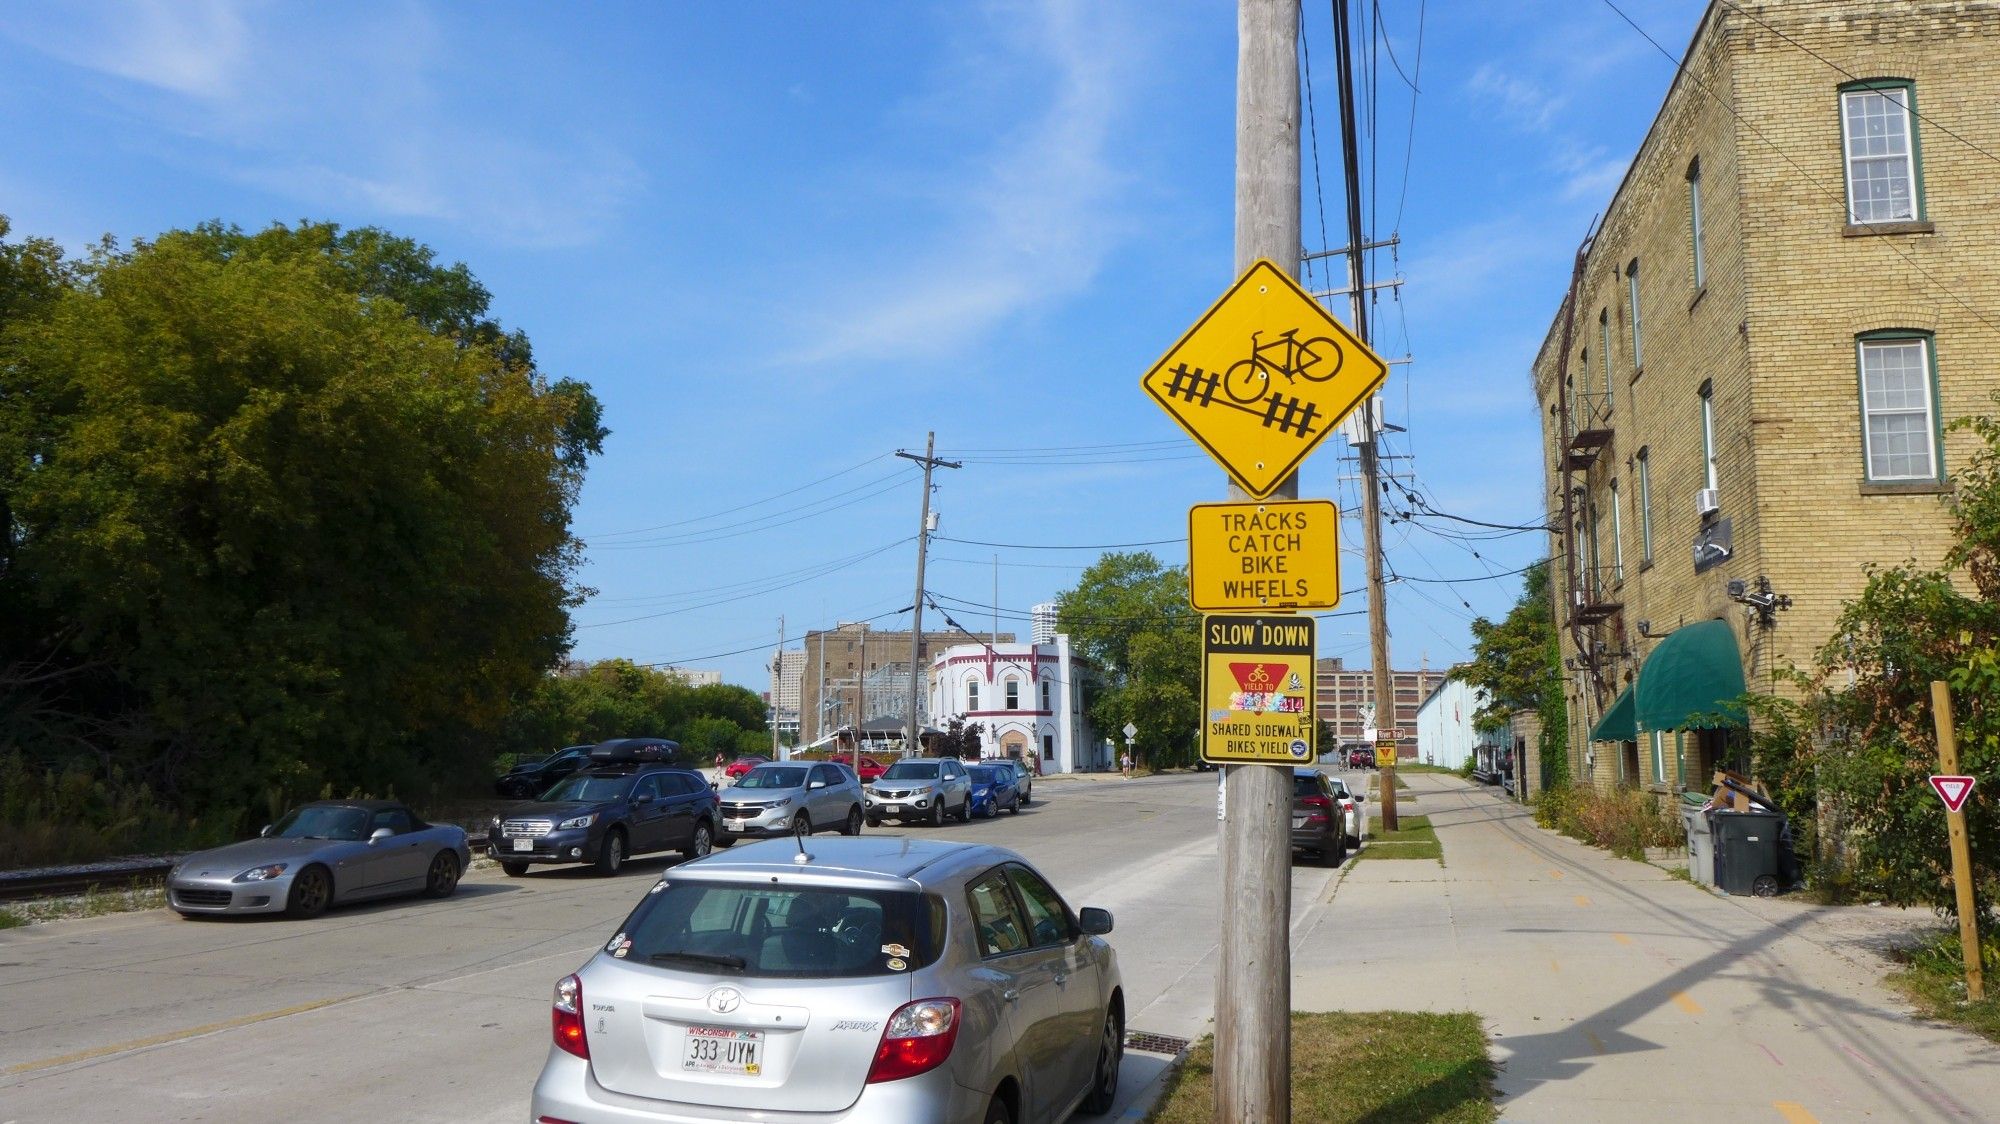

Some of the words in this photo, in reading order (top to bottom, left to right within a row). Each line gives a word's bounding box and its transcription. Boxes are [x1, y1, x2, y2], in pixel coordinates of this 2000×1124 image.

[1221, 511, 1307, 532] TRACKS
[1229, 534, 1301, 553] CATCH
[1242, 555, 1288, 575] BIKE
[1223, 578, 1308, 599] WHEELS
[1211, 624, 1254, 646] SLOW
[1262, 625, 1309, 647] DOWN
[1243, 682, 1263, 691] YIELD
[1265, 683, 1274, 691] TO
[1212, 723, 1251, 737] SHARED
[1255, 724, 1304, 738] SIDEWALK
[1392, 730, 1403, 739] Trail
[1227, 740, 1256, 753] BIKES
[1259, 741, 1289, 755] YIELD
[688, 1026, 730, 1039] WISCONSIN
[829, 1020, 879, 1032] MATRIX
[690, 1038, 719, 1061] 333
[727, 1041, 756, 1064] UYM
